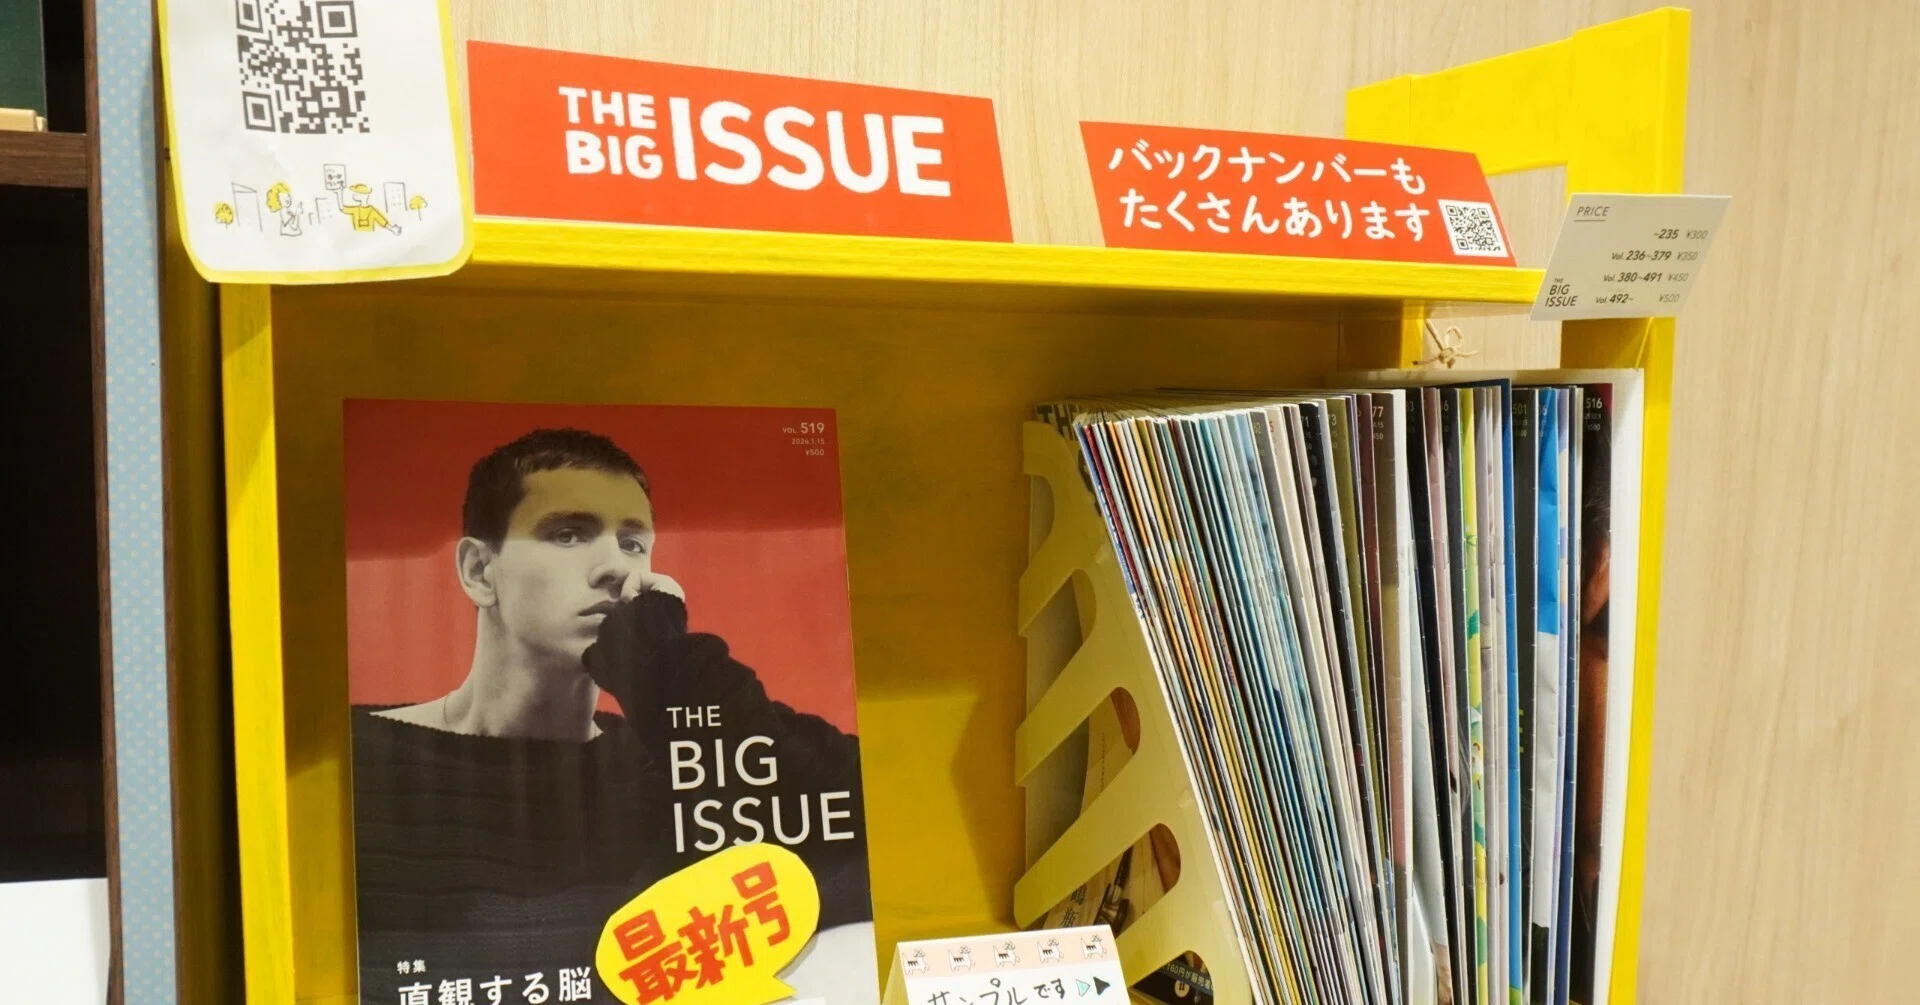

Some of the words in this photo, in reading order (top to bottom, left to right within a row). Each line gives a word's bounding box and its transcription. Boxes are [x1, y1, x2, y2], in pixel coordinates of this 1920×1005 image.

[558, 86, 657, 129] THE
[565, 131, 663, 179] BIG
[669, 96, 951, 197] ISSUE
[1108, 138, 1426, 195] バックナンバーも
[1119, 188, 1430, 241] たくさんあります
[1576, 206, 1610, 217] PRICE
[1545, 296, 1578, 307] ISSUE
[1549, 284, 1570, 295] BIG
[1585, 397, 1603, 409] 516
[800, 422, 825, 434] 519
[666, 705, 722, 729] THE
[670, 735, 778, 791] BIG
[674, 791, 855, 853] ISSUE
[613, 861, 791, 1005] 最新号
[397, 959, 427, 974] 特集
[398, 966, 592, 1005] 直観する脳
